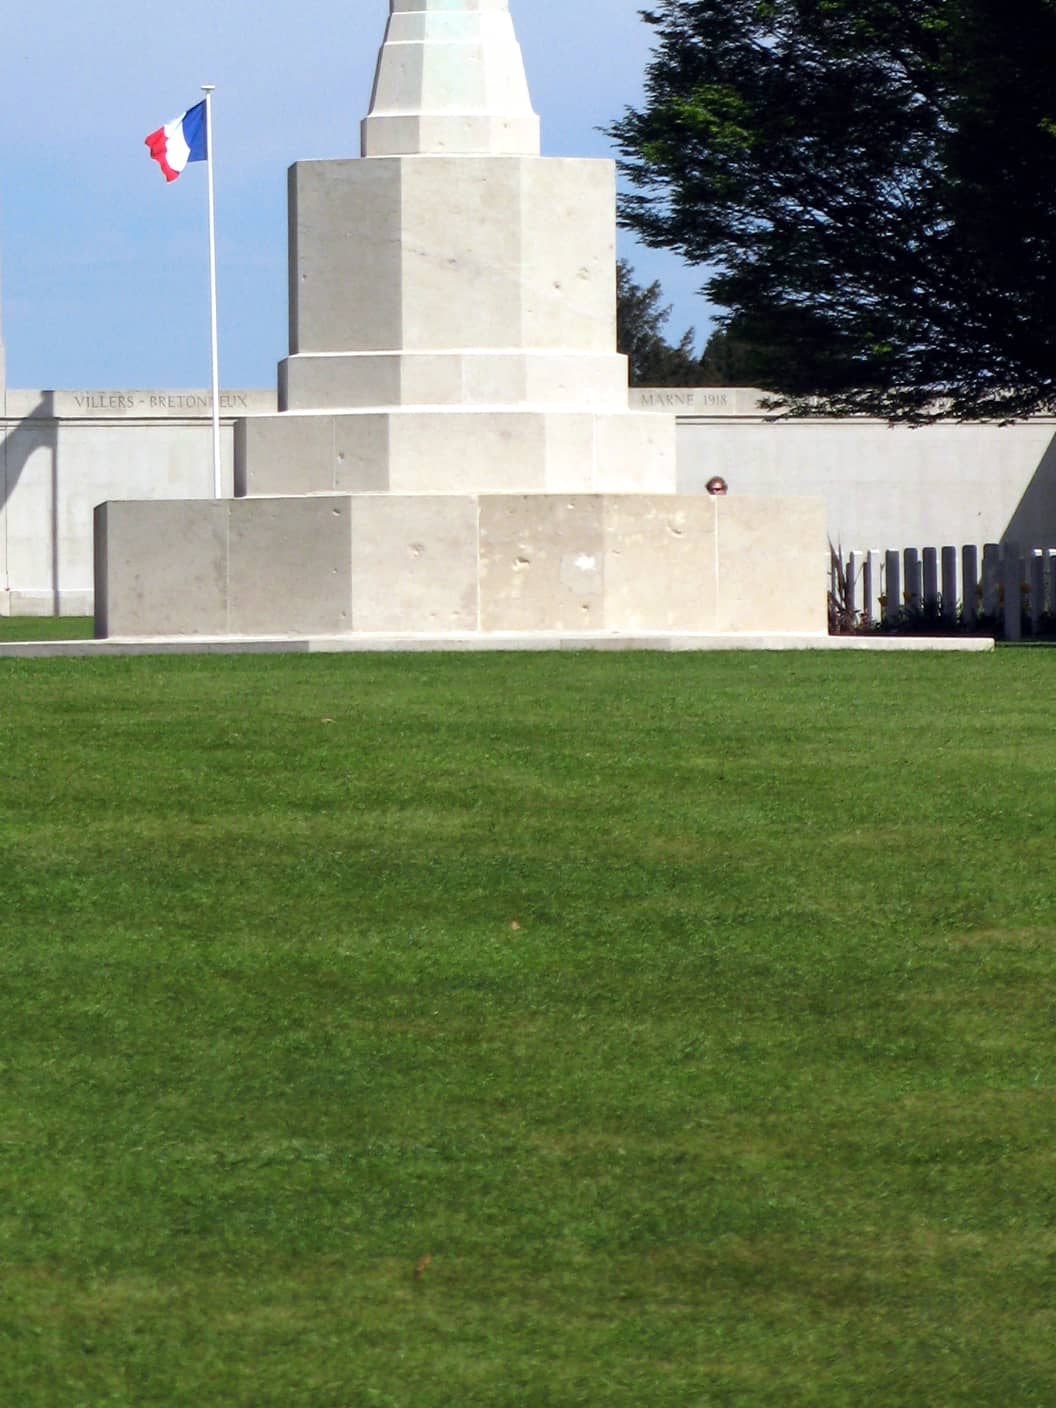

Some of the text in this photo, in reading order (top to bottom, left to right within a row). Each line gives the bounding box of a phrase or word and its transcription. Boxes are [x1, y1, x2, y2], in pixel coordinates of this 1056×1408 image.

[74, 396, 134, 409] VILLERS
[150, 395, 248, 408] BRETONEUX
[640, 394, 728, 407] MARNE 1918
